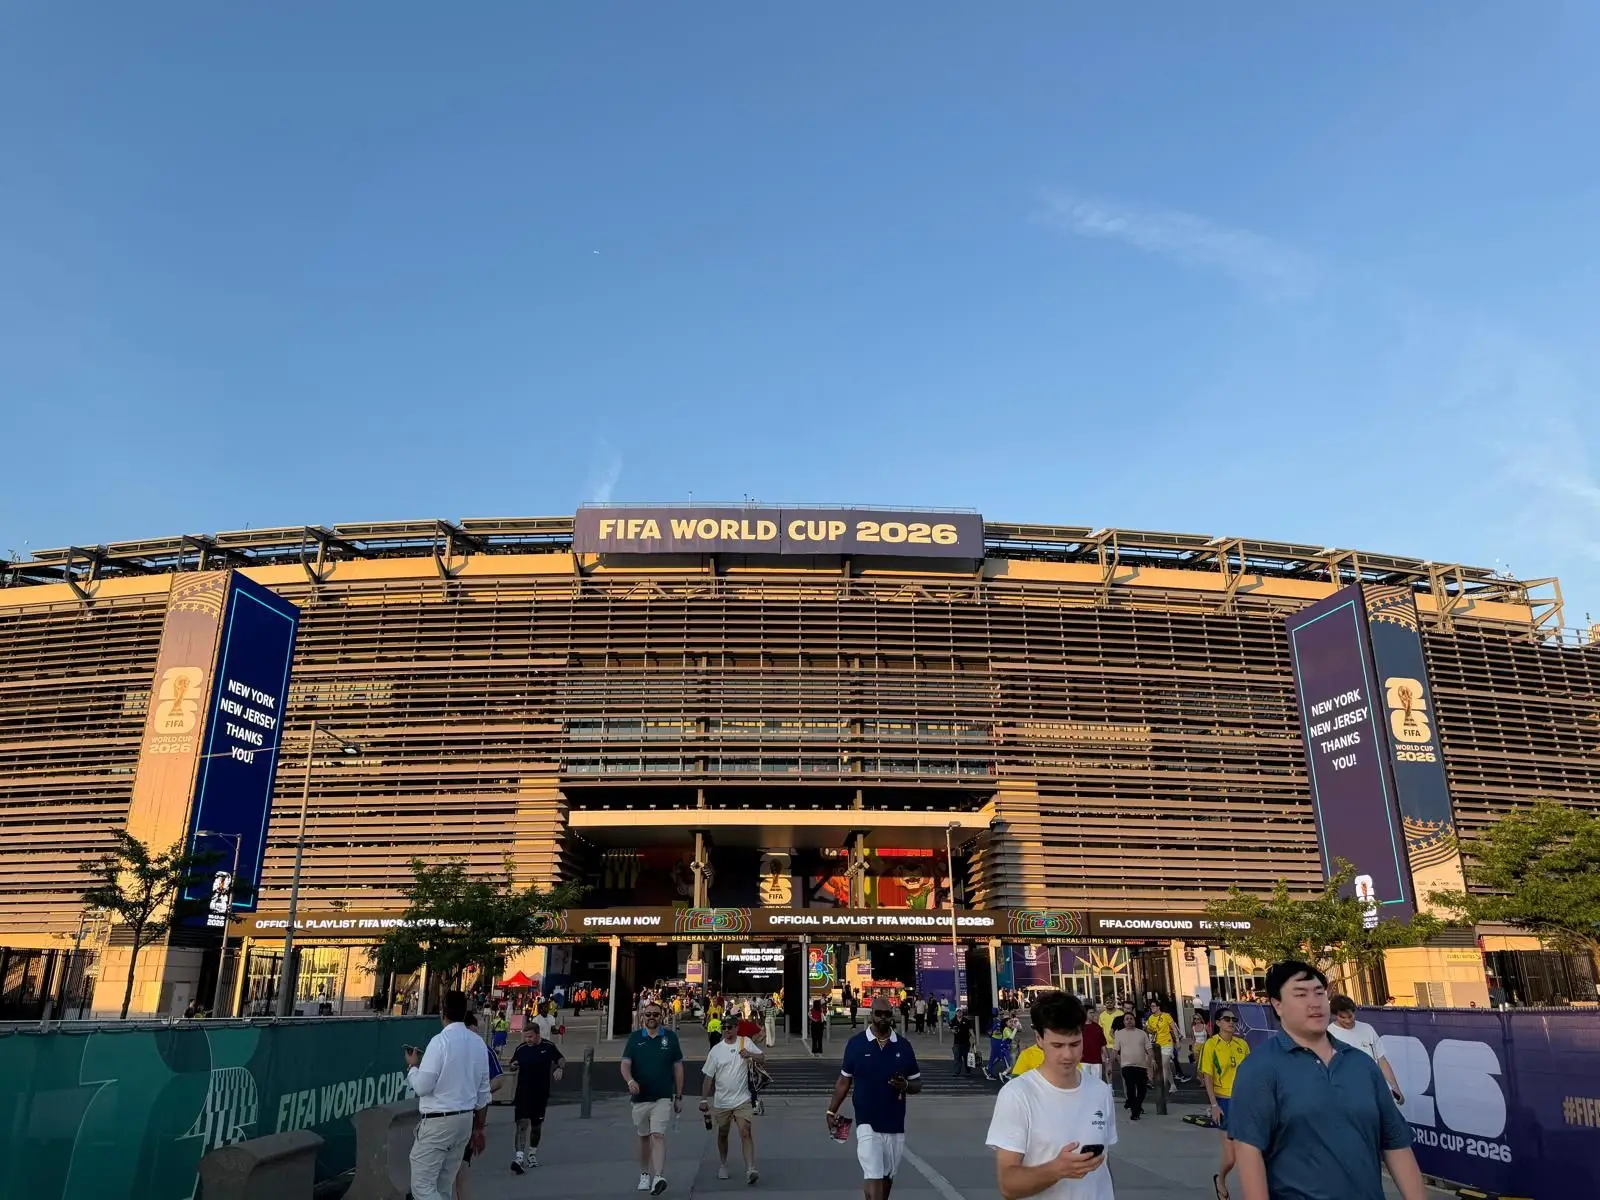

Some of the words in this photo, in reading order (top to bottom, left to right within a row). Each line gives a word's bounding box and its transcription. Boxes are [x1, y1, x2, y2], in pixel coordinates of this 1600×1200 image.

[599, 519, 662, 540] FIFA
[671, 518, 777, 541] WORLD
[788, 519, 846, 541] CUP
[856, 521, 958, 544] 2026
[228, 679, 251, 699] NEW
[251, 688, 275, 709] YORK
[1311, 699, 1332, 717] NEW
[1333, 688, 1362, 709] YORK
[220, 698, 243, 717] NEW
[243, 708, 276, 730] JERSEY
[1310, 720, 1331, 738] NEW
[1333, 706, 1368, 731] JERSEY
[165, 720, 184, 728] FIFA
[1403, 729, 1421, 737] FIFA
[151, 735, 177, 743] WORLD
[226, 722, 263, 746] THANKS
[1321, 732, 1361, 754] THANKS
[149, 743, 192, 754] 2026
[231, 746, 254, 764] YOU!
[1396, 752, 1436, 762] 2026
[1420, 744, 1434, 752] CUP
[1332, 753, 1357, 771] YOU!
[306, 919, 357, 928] PLAYLIST
[358, 919, 379, 928] FIFA
[584, 917, 631, 926] STREAM
[633, 916, 661, 925] NOW
[769, 916, 819, 925] OFFICIAL
[822, 916, 874, 925] PLAYLIST
[877, 916, 898, 925] FIFA
[899, 916, 935, 925] WORLD
[957, 917, 991, 926] 2026
[1099, 919, 1193, 929] FIFA.COM/SOUND
[275, 1088, 317, 1134] FIFA
[320, 1076, 375, 1124] WORLD
[377, 1071, 405, 1105] CUP
[1440, 1134, 1465, 1152] CUP
[1466, 1138, 1513, 1163] 2026
